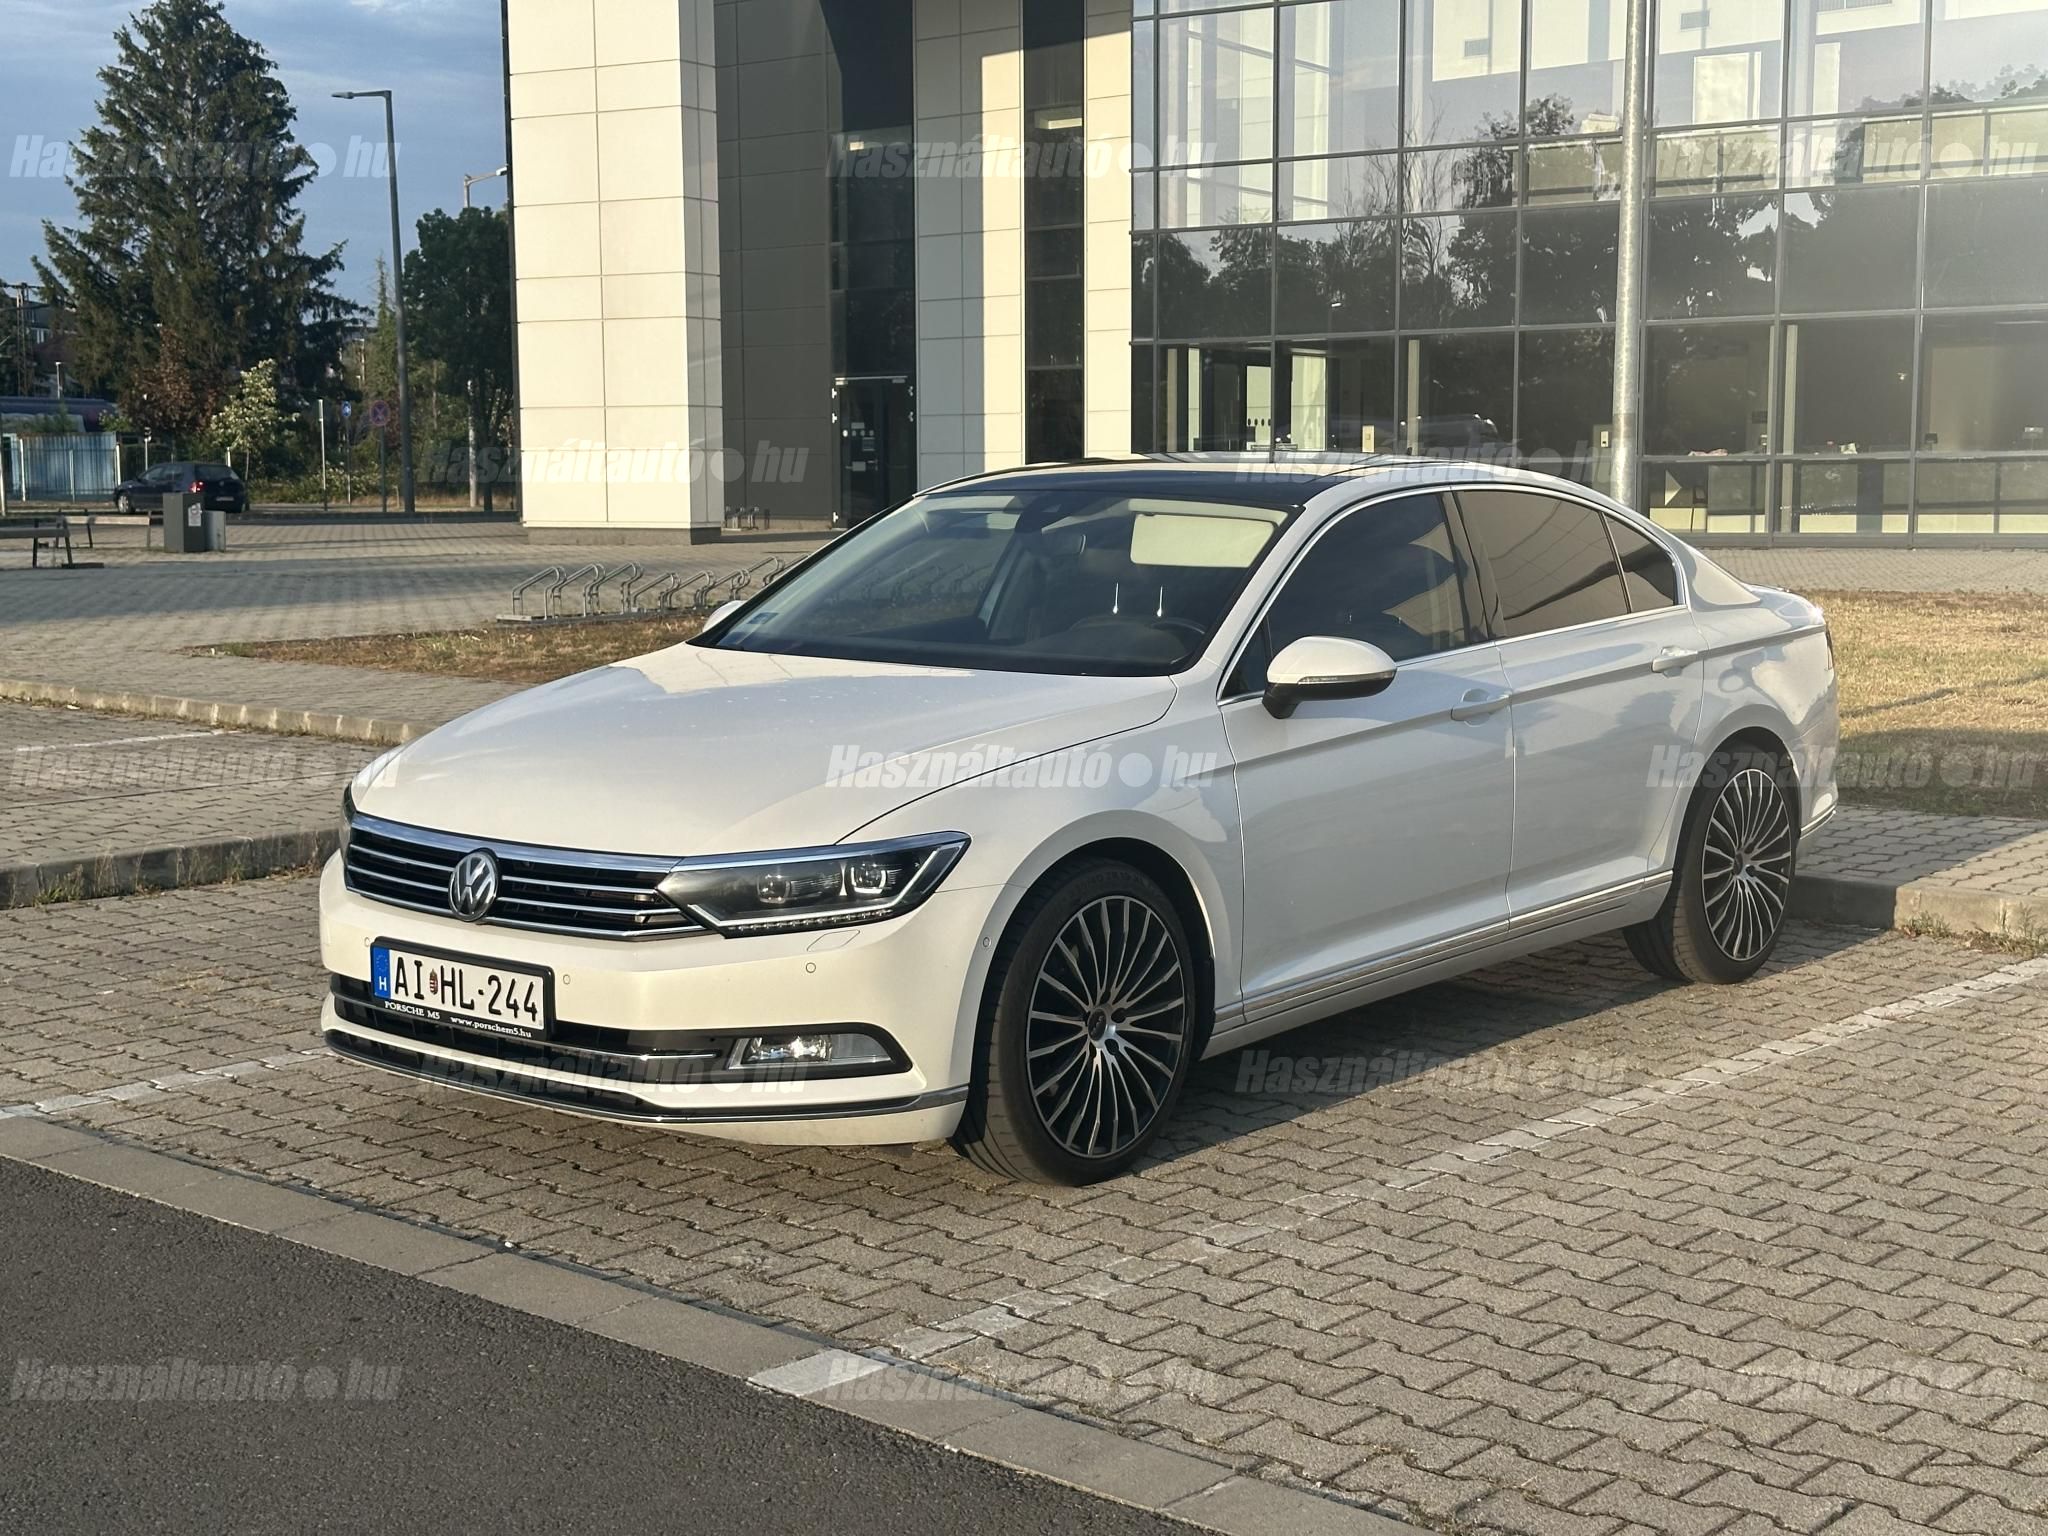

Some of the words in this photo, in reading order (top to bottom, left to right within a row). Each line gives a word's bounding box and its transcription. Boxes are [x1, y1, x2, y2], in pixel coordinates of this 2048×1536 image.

[378, 976, 388, 991] H
[384, 1001, 425, 1016] PORSCHE
[427, 1010, 440, 1019] M5
[450, 1017, 532, 1038] www.porschem5.hu
